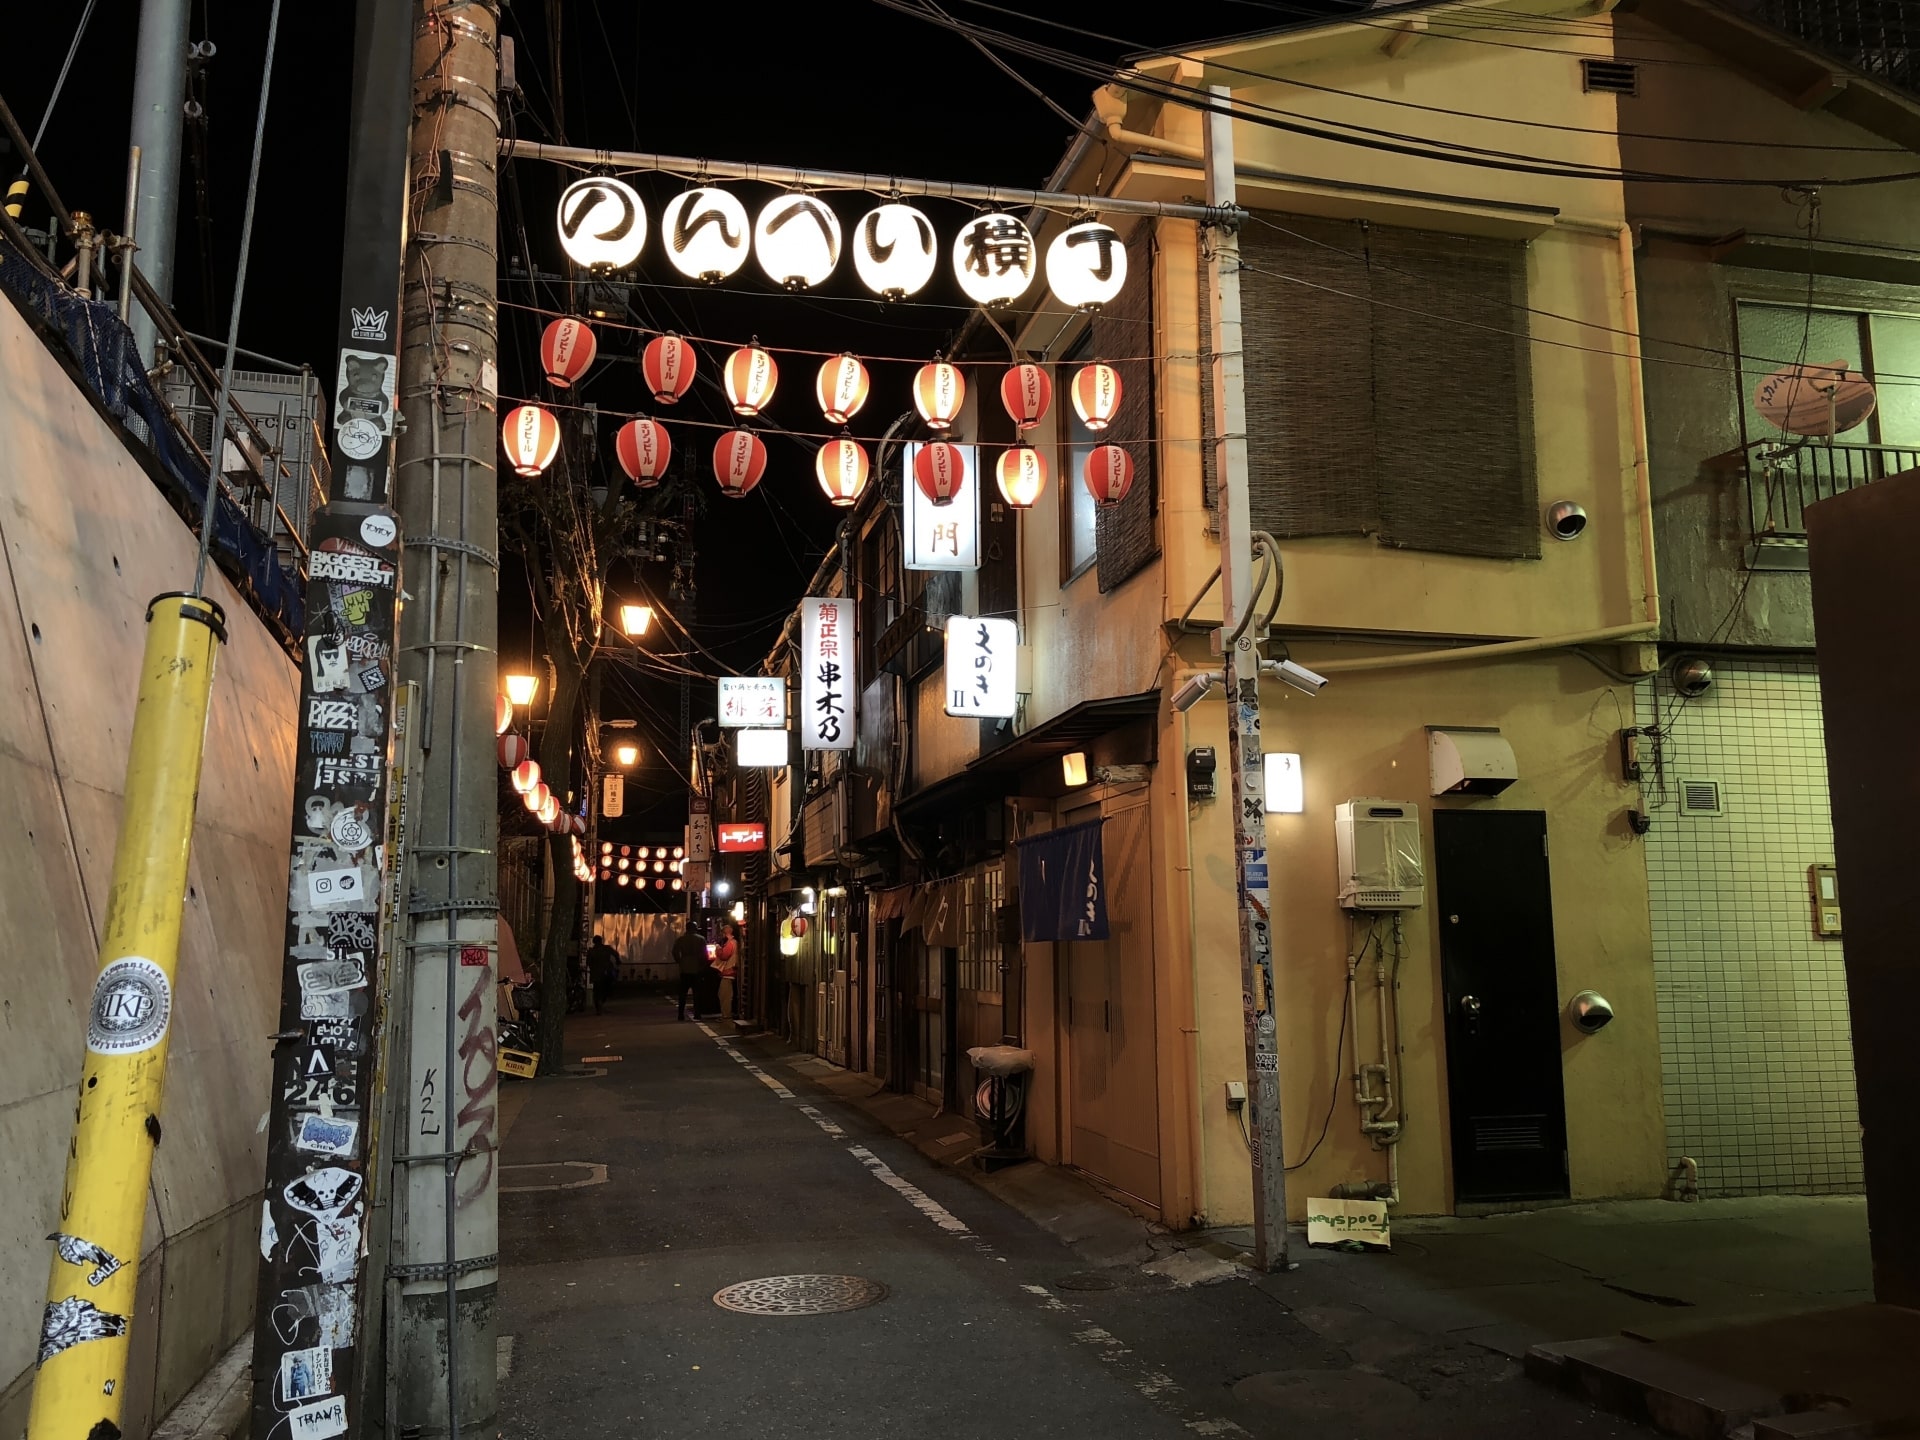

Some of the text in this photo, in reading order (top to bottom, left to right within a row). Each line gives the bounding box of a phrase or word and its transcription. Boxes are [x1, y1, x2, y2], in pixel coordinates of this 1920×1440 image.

[556, 321, 573, 363] キリンビール
[664, 340, 677, 380] キリンビール
[1025, 367, 1036, 407] キリンビール
[523, 410, 535, 453] キリンビール
[639, 423, 653, 465] キリンビール
[733, 435, 749, 476] キリンビール
[935, 446, 948, 486] キリンビール
[1112, 449, 1121, 488] キリンビール
[932, 522, 958, 556] 門
[309, 563, 394, 585] BADDEST
[311, 551, 382, 570] BIGGEST
[819, 603, 838, 659] 菊正宗
[974, 623, 993, 707] えのき
[816, 661, 845, 742] 串木乃
[103, 993, 154, 1018] IKP
